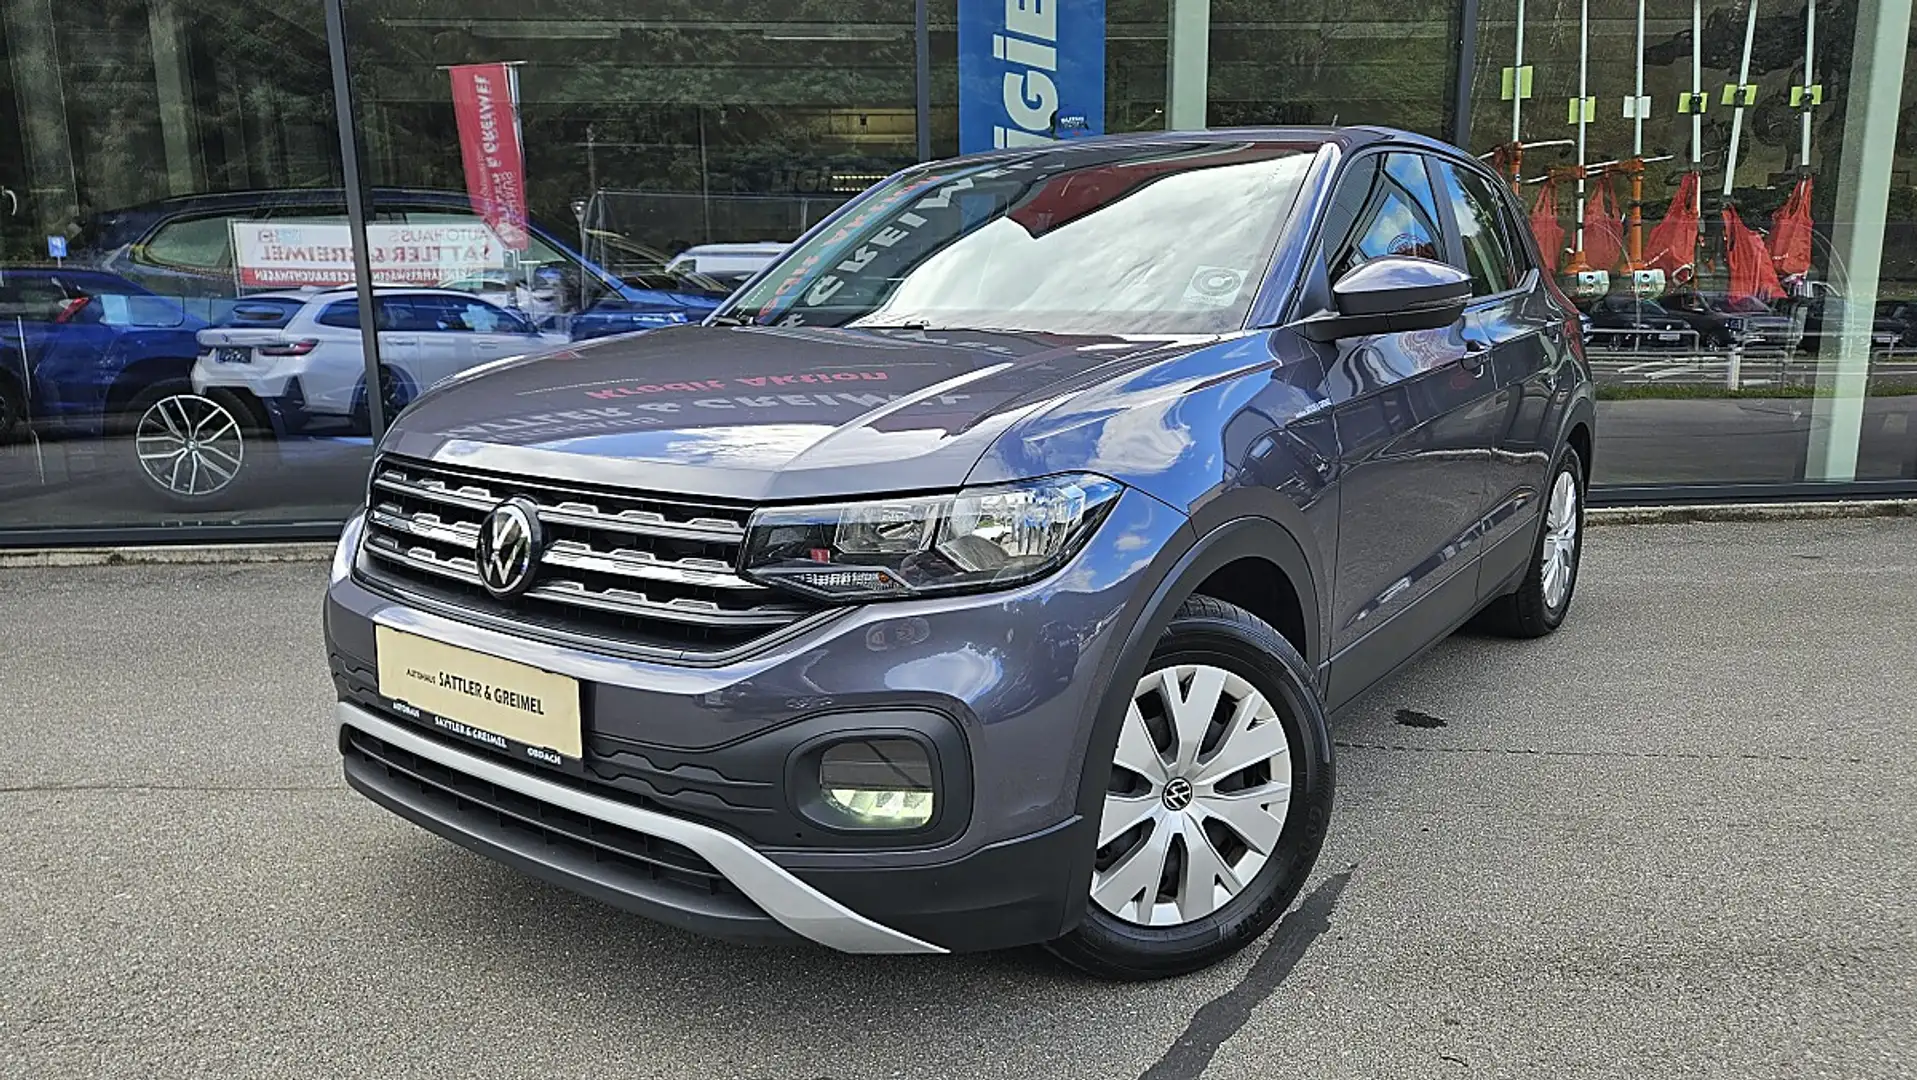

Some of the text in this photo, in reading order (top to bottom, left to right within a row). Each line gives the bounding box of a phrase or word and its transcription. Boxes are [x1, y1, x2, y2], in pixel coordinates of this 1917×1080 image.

[439, 671, 482, 698] SATTLER
[484, 685, 492, 701] &
[494, 687, 545, 715] GREIMEL
[434, 716, 466, 734] SATTLER
[473, 729, 508, 748] GREIMEL
[527, 747, 562, 765] OBDACH
